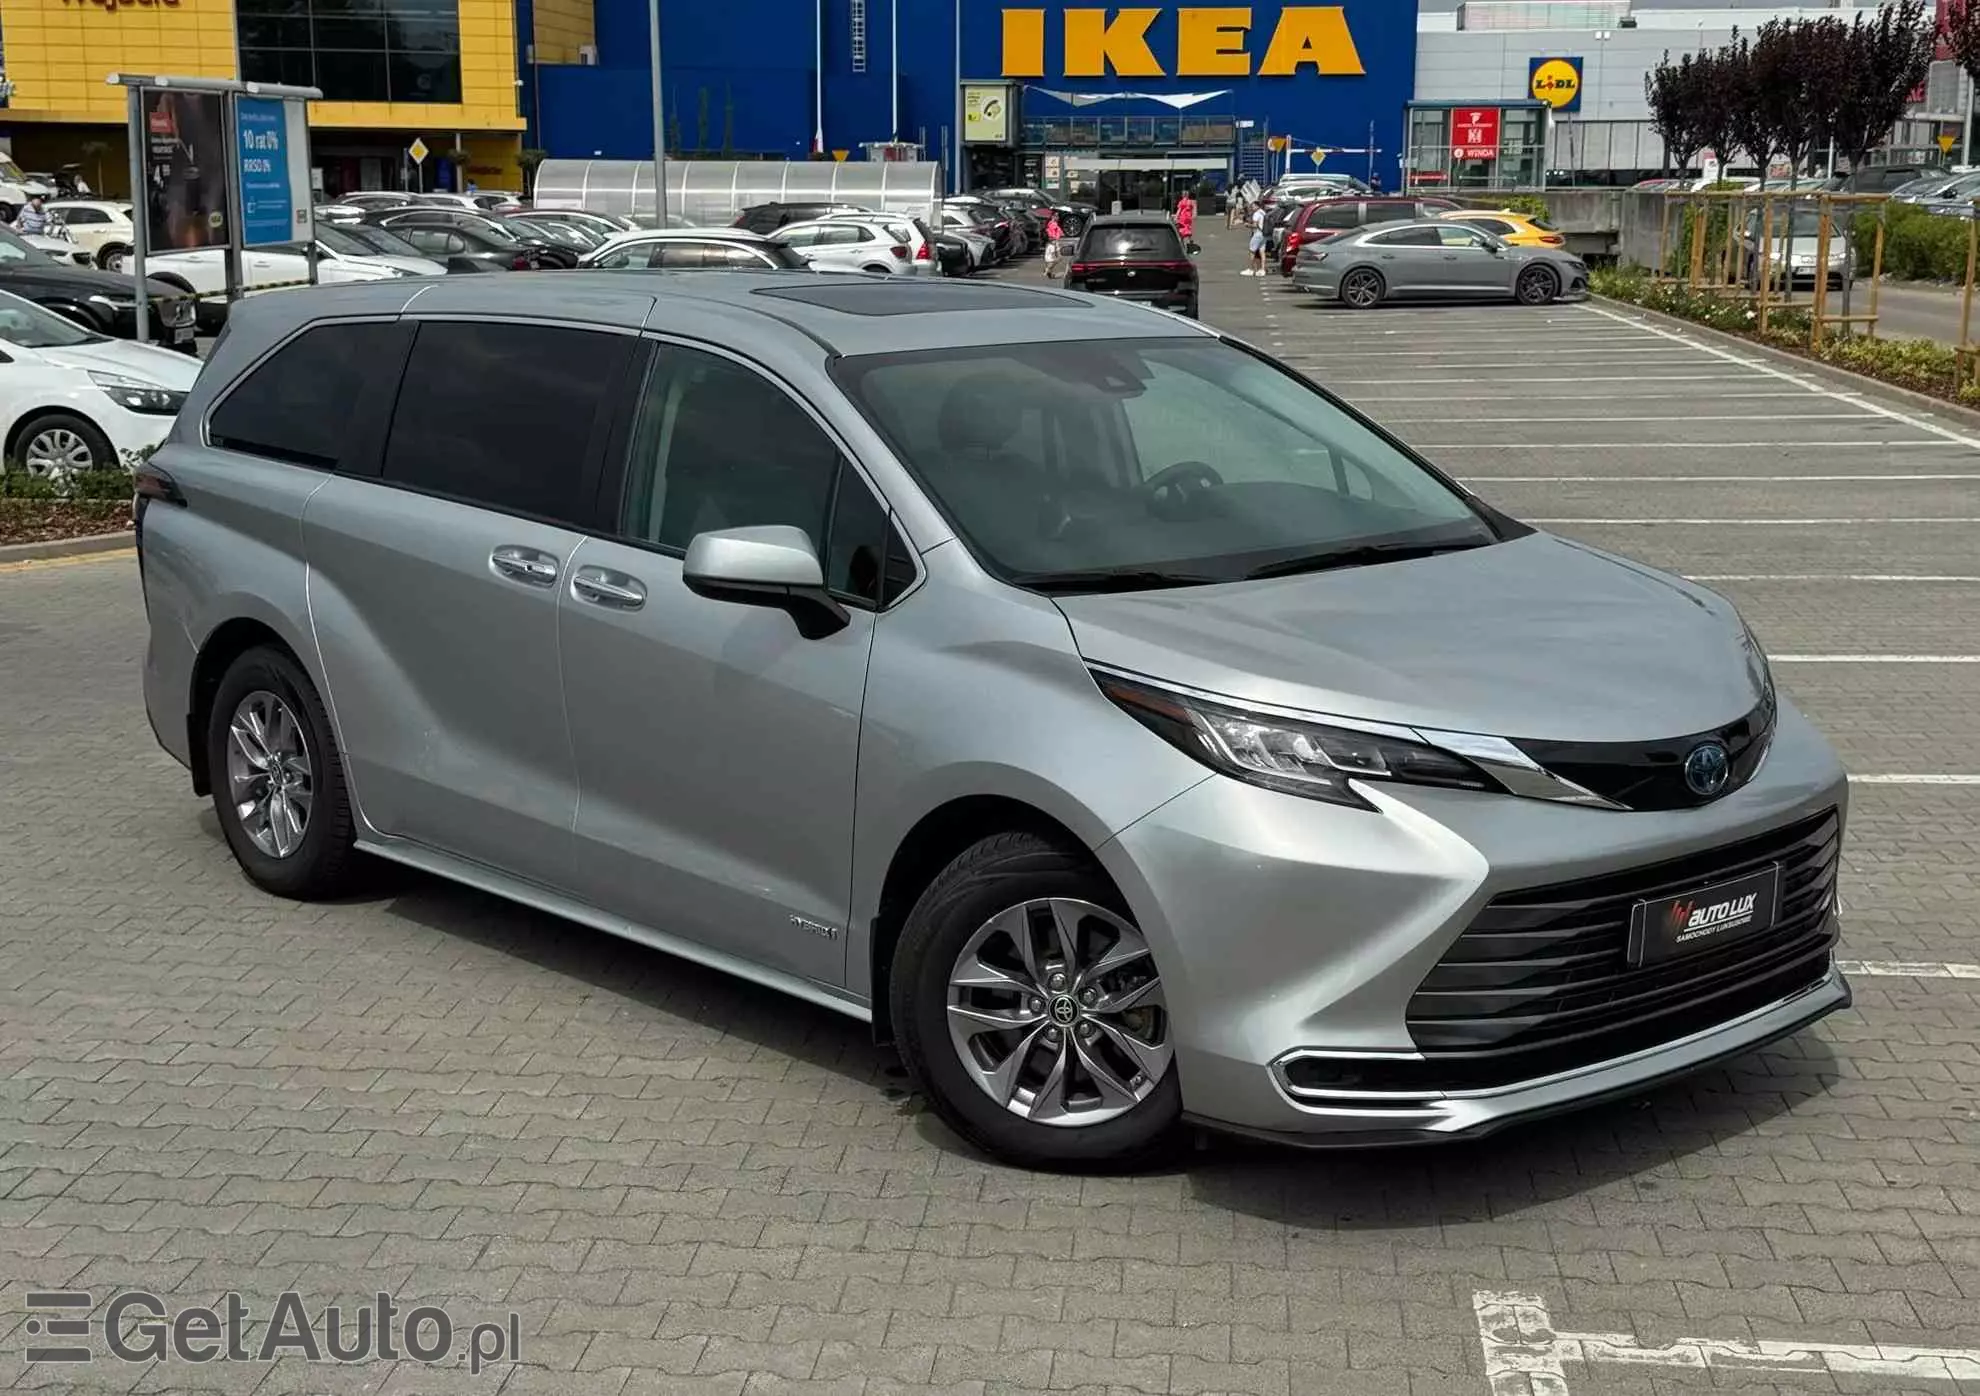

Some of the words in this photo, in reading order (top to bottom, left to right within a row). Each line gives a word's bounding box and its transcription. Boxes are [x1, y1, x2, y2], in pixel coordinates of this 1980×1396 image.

[1000, 7, 1366, 76] IKEA
[243, 129, 255, 150] 10
[1729, 892, 1757, 916] LUX
